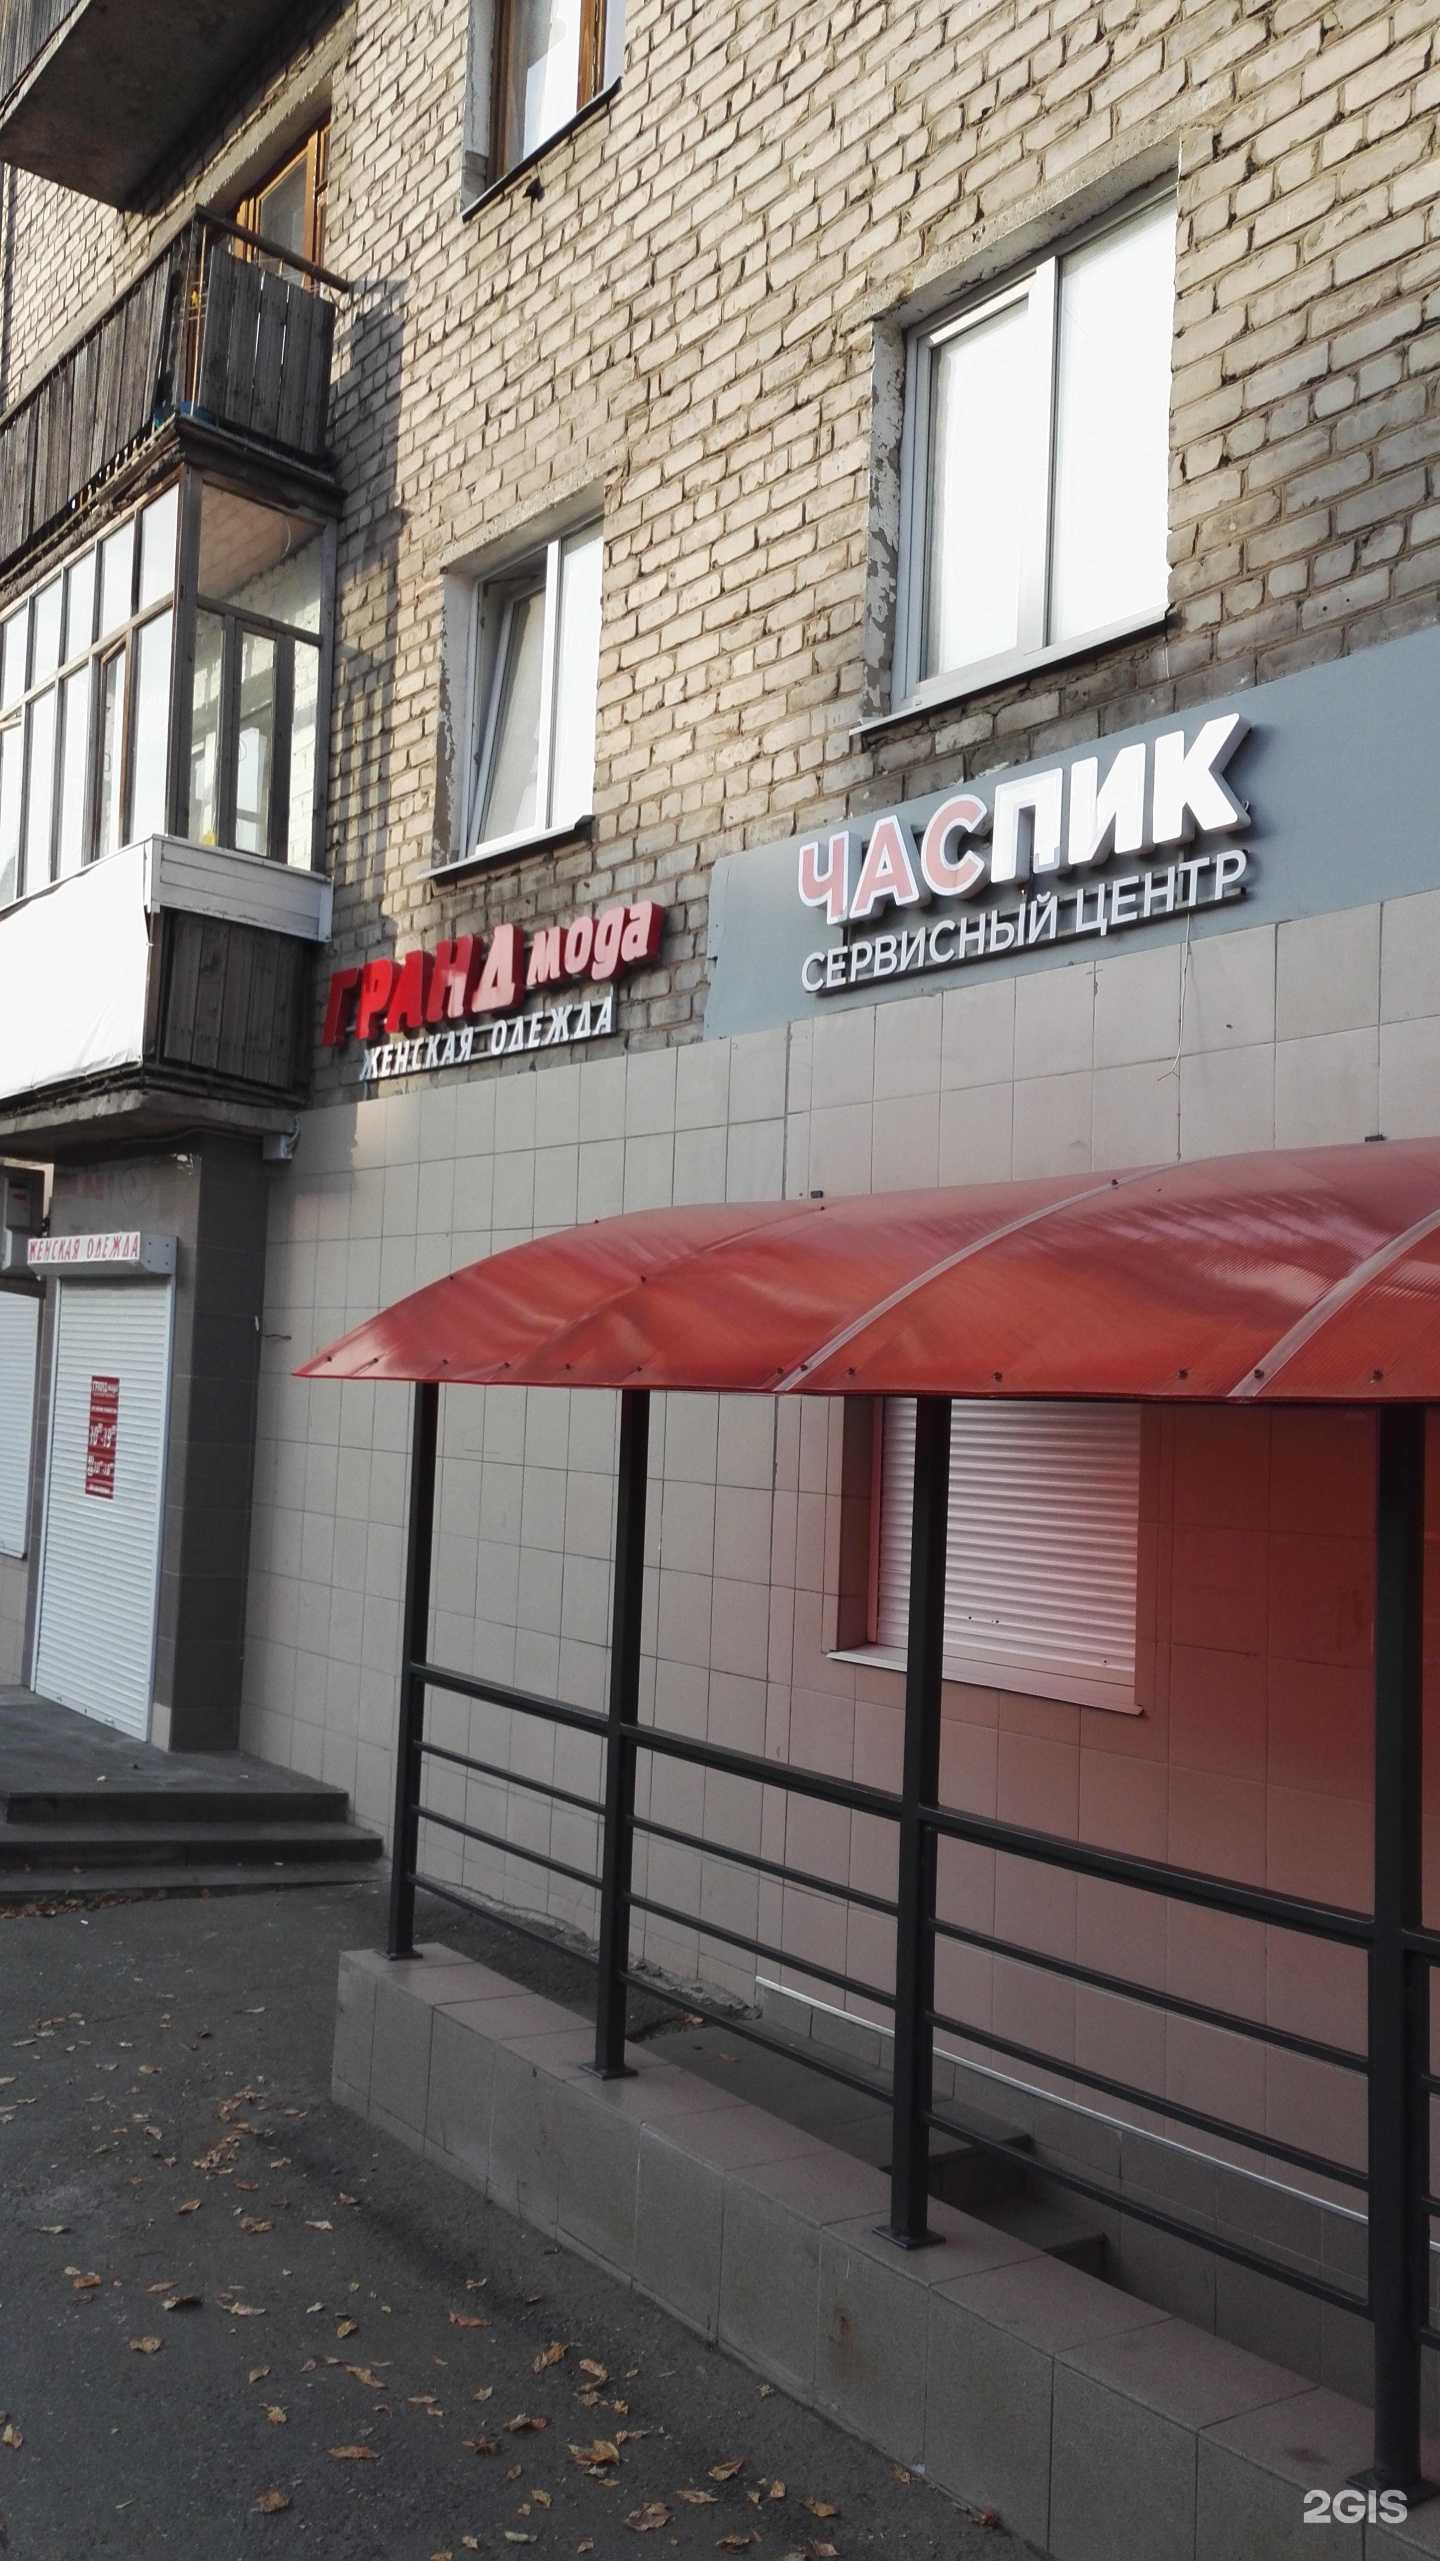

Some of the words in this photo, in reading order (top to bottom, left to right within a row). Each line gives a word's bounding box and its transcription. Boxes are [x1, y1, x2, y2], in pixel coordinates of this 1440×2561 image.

[801, 894, 1058, 993] СЕРВИСНЫЙ
[1075, 849, 1248, 936] ЦЕНТР
[321, 923, 524, 1046] ГРАНД
[360, 1027, 473, 1080] ЖЕНСКАЯ
[490, 996, 614, 1054] ОДЕЖДА
[29, 1238, 81, 1262] ЖЕНСКАЯ
[87, 1234, 139, 1259] ОДЕЖДА
